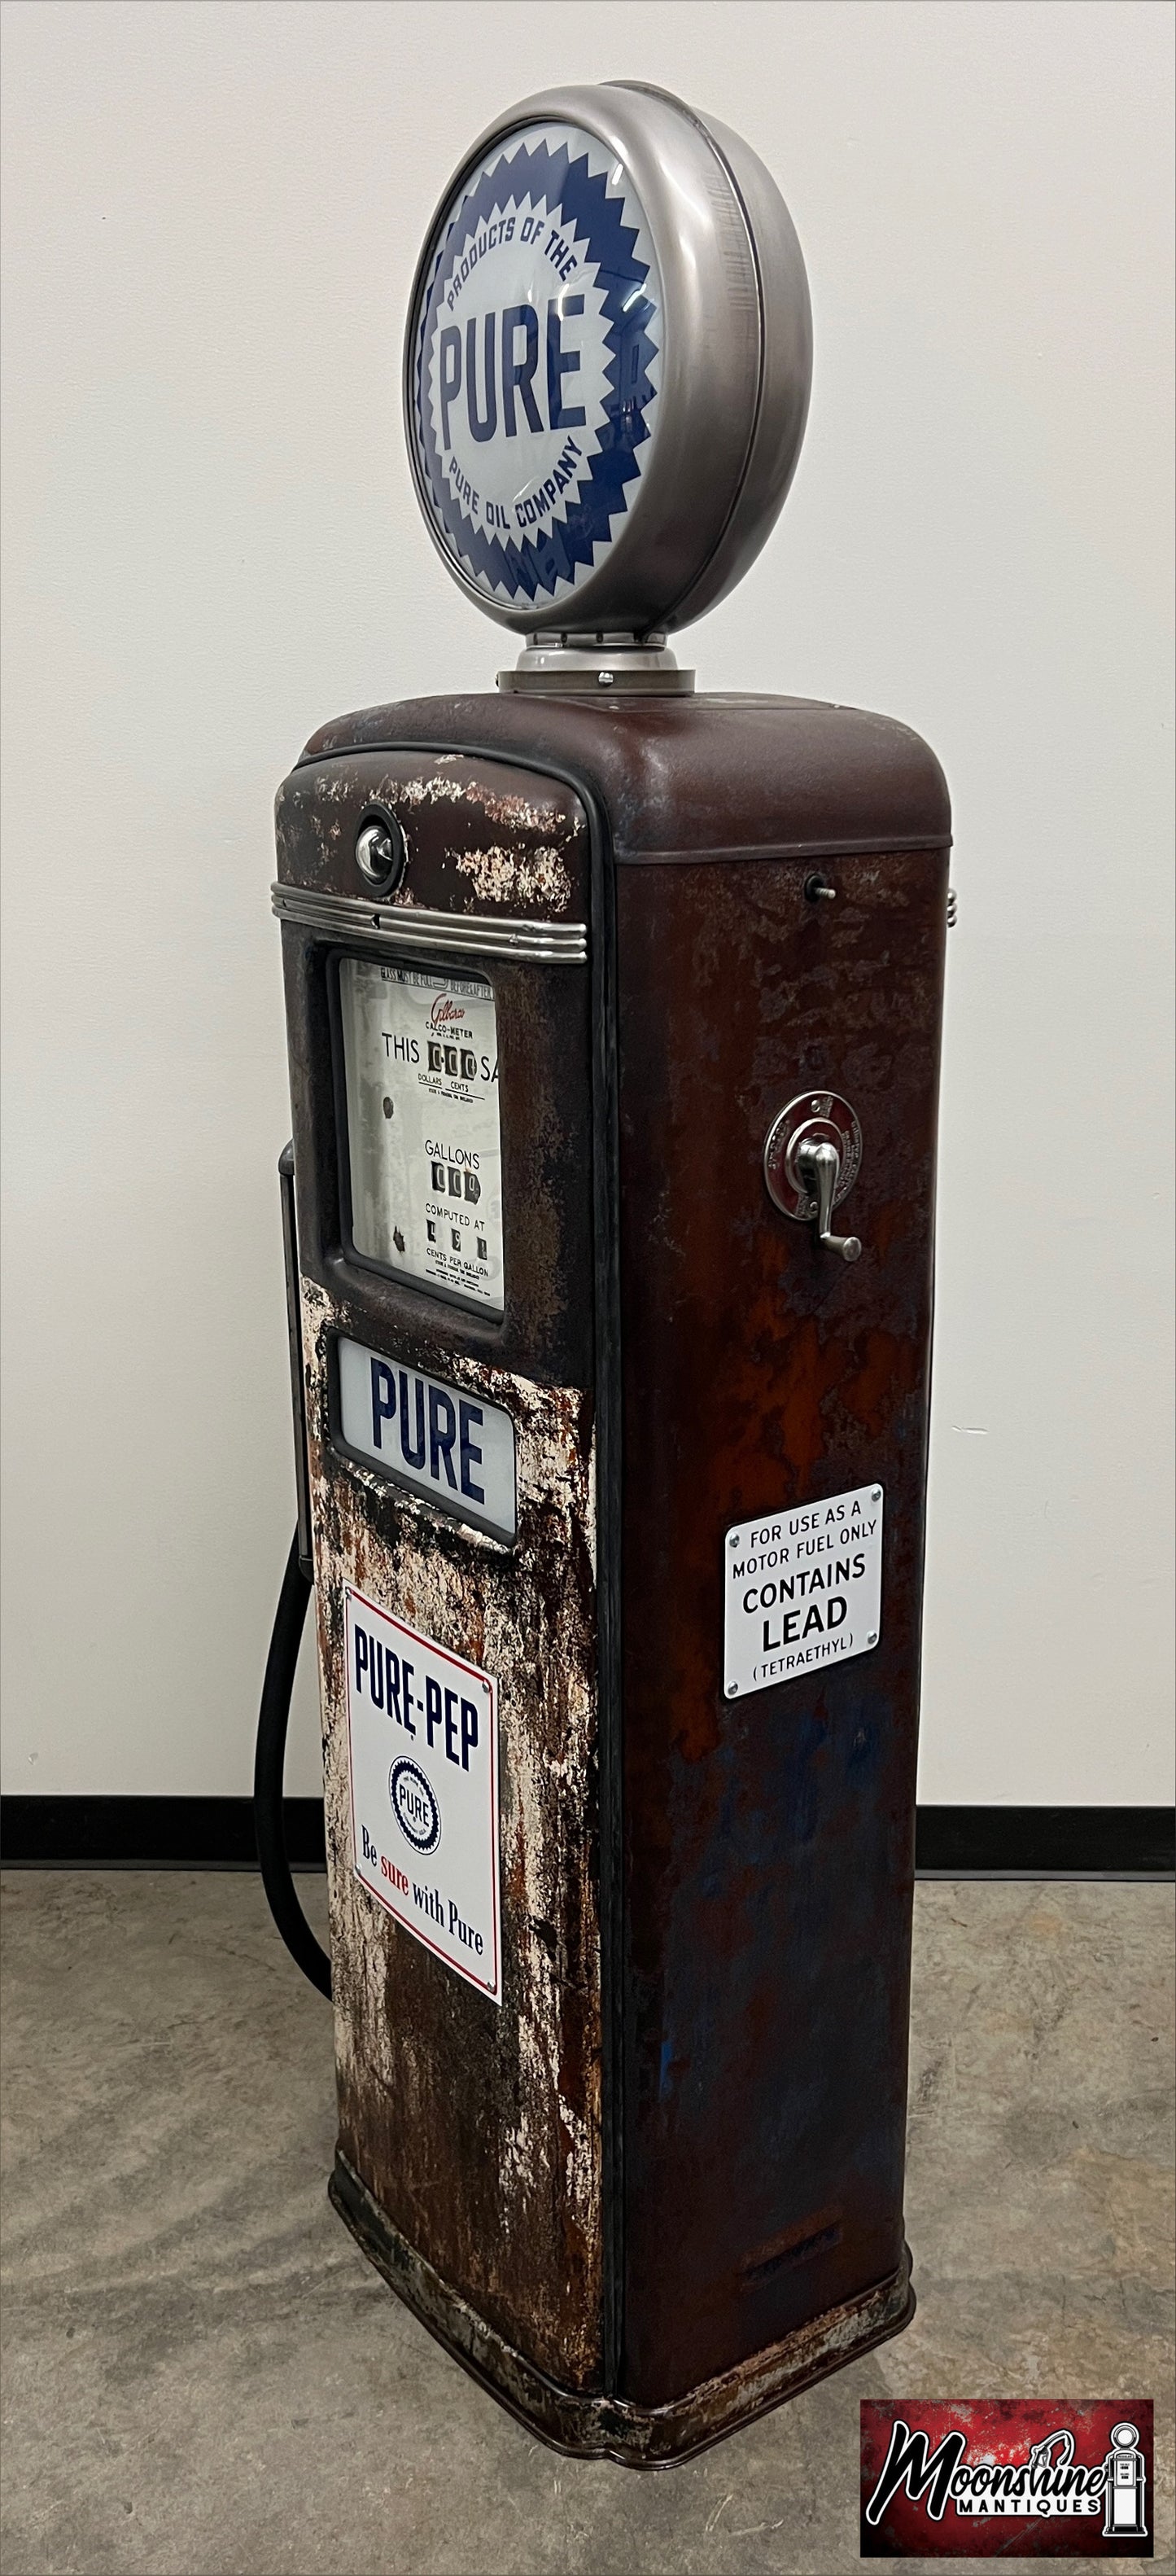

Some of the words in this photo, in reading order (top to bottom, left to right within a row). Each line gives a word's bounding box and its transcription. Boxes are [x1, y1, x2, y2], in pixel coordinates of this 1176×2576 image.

[447, 217, 516, 312] PRODUCTS
[520, 217, 544, 245] OF
[544, 229, 578, 282] THE
[439, 294, 587, 451] PURE
[449, 456, 479, 515] PURE
[486, 501, 510, 529] OIL
[514, 435, 582, 528] COMPANY
[382, 1032, 420, 1063] THIS
[426, 1022, 473, 1039] CALCO-METER
[418, 1073, 442, 1085] DOLLARS
[450, 1081, 469, 1093] CENTS
[425, 1140, 479, 1169] GALLONS
[425, 1203, 470, 1226] COMPUTED
[474, 1220, 485, 1231] AT
[426, 1247, 447, 1262] CENTS
[449, 1256, 461, 1268] PER
[464, 1262, 489, 1277] GALLON
[370, 1357, 485, 1505] PURE
[732, 1548, 789, 1579] MOTOR
[797, 1534, 833, 1558] FUEL
[840, 1519, 877, 1544] ONLY
[750, 1525, 782, 1548] FOR
[789, 1513, 820, 1536] USE
[825, 1505, 845, 1525] AS
[850, 1500, 861, 1517] A
[742, 1553, 866, 1614] CONTAINS
[763, 1596, 848, 1652] LEAD
[753, 1632, 854, 1681] (TETRAETHYL)
[354, 1623, 479, 1772] PURE-PEP
[400, 1782, 430, 1827] PURE
[361, 1825, 378, 1868] Be
[380, 1853, 409, 1896] sure
[413, 1877, 444, 1927] with
[448, 1899, 483, 1956] Pure
